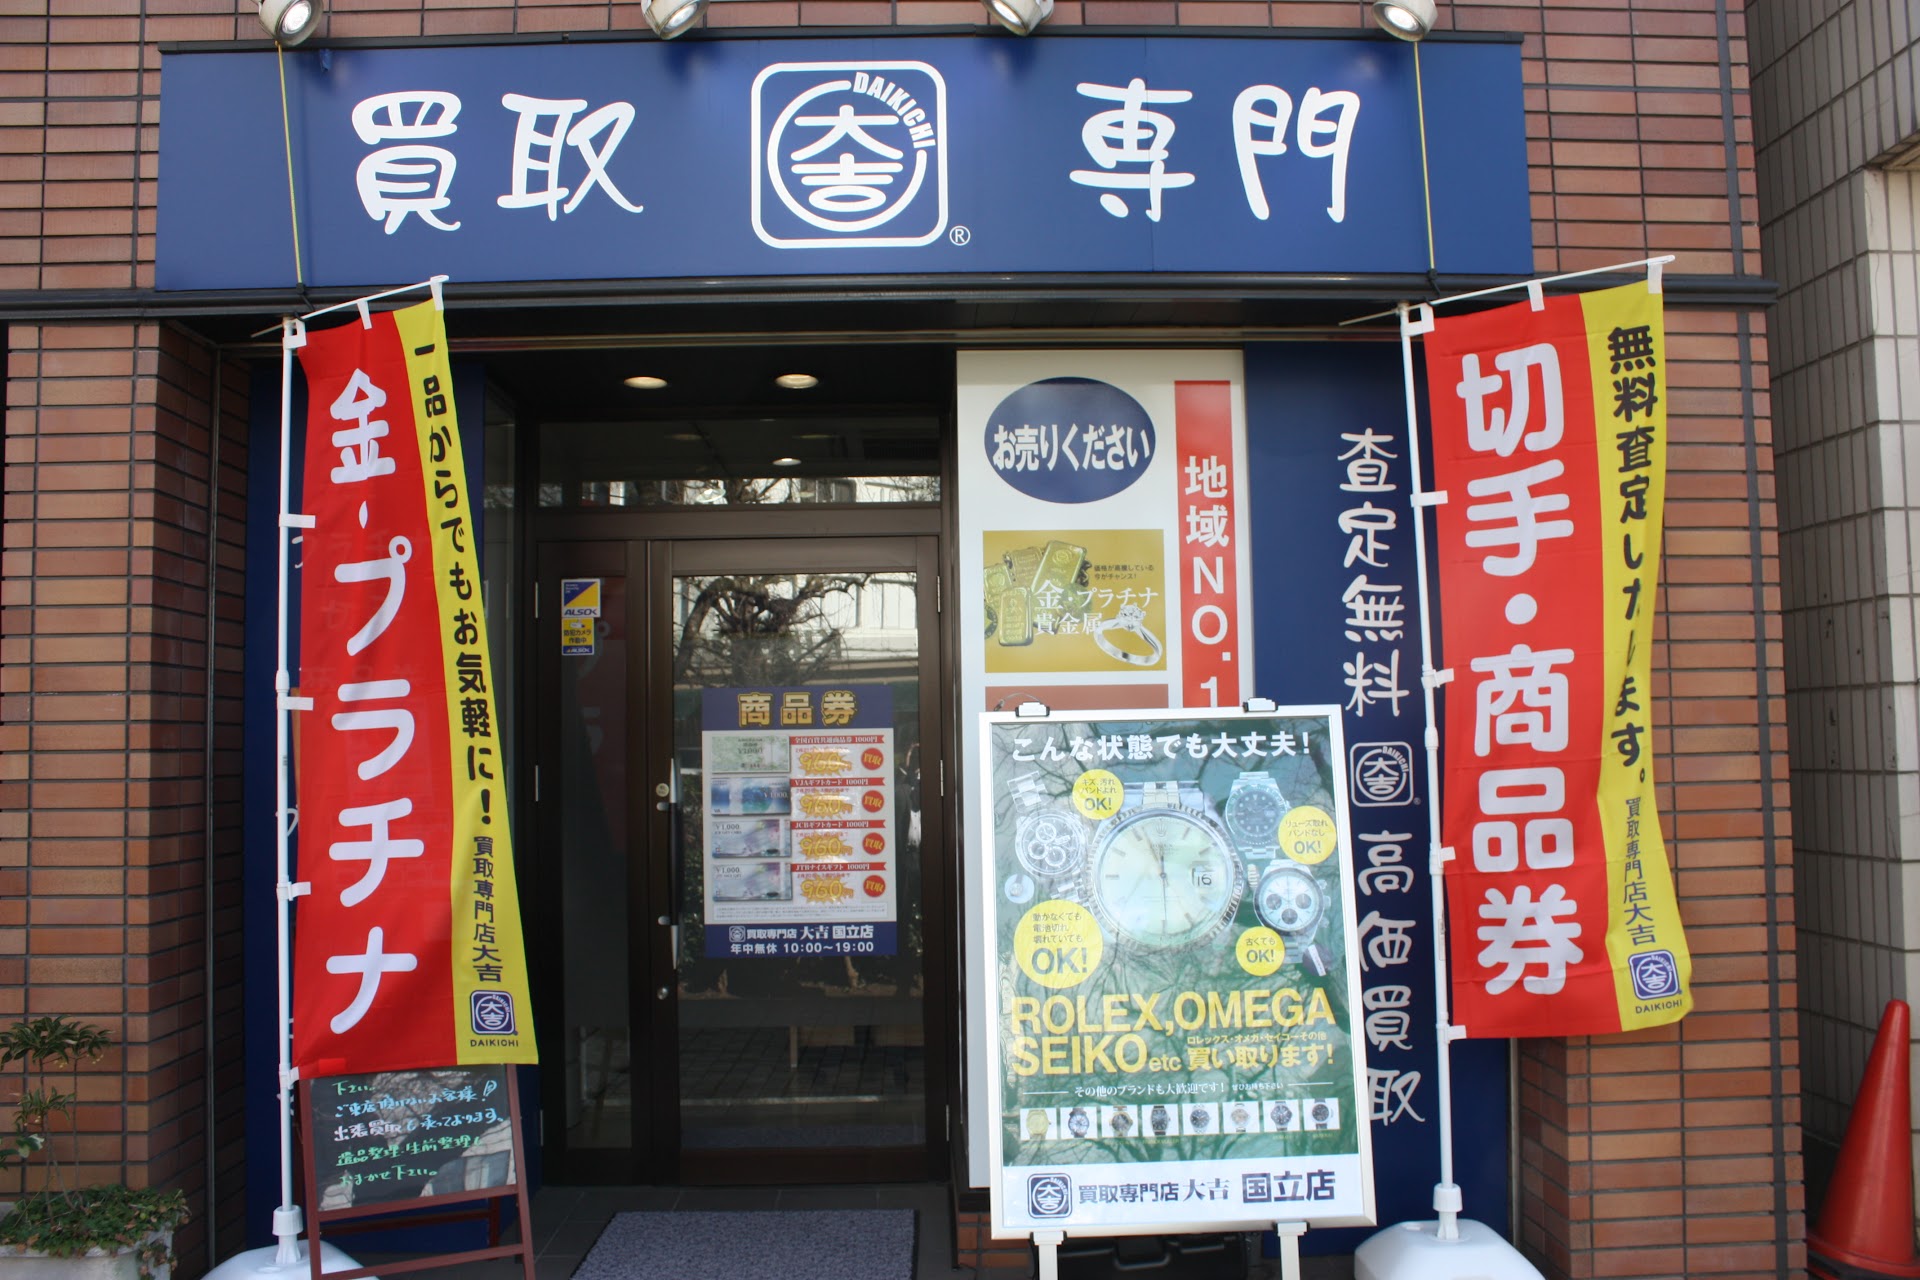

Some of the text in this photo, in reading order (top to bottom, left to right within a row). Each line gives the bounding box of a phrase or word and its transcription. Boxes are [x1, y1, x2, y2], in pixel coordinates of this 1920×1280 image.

[853, 72, 936, 149] DAIKICHI
[352, 78, 1361, 235] 買取 専門
[992, 422, 1151, 473] お売りください
[1610, 325, 1658, 784] 無料査定いたます。
[1337, 427, 1411, 717] 査定無料
[1034, 578, 1160, 610] 金・プラチナ
[564, 608, 598, 616] ALSOK
[1033, 611, 1103, 636] 貴金属
[1456, 342, 1584, 995] 切手・商品券
[322, 368, 424, 1035] 金・プラチナ
[737, 689, 858, 727] 商品券
[1011, 730, 1311, 762] こんな状態でも大丈夫!
[1382, 745, 1410, 773] DAIKICHI
[845, 778, 869, 786] 1000円
[1083, 796, 1113, 812] OK!
[845, 820, 869, 828] 1000円
[1285, 818, 1329, 829] リューズ取れ
[1289, 828, 1326, 839] バンドなし
[1293, 840, 1323, 855] OK!
[846, 862, 870, 870] 1000円
[1623, 796, 1656, 947] 買取専門店大吉
[472, 836, 503, 983] 買取専門店大吉
[1032, 911, 1082, 922] 動かなくても
[746, 924, 874, 940] 買取専門店 大吉 国立店
[1032, 922, 1070, 933] 電池切れ
[730, 942, 778, 955] 年中無休
[1033, 933, 1084, 945] 壊れていても
[1245, 937, 1276, 947] 古くても
[1031, 946, 1088, 976] OK!
[1246, 950, 1275, 963] OK!
[1357, 829, 1426, 1127] 高価買取
[1635, 1000, 1683, 1015] DAIKICHI
[470, 1038, 519, 1048] DAIKICHI
[1011, 1033, 1335, 1077] SEIKO etc 買い取ります!
[1074, 1081, 1225, 1099] その他のブランドも大歓迎です!
[1078, 1168, 1337, 1205] 買取専門店 大吉 国立店
